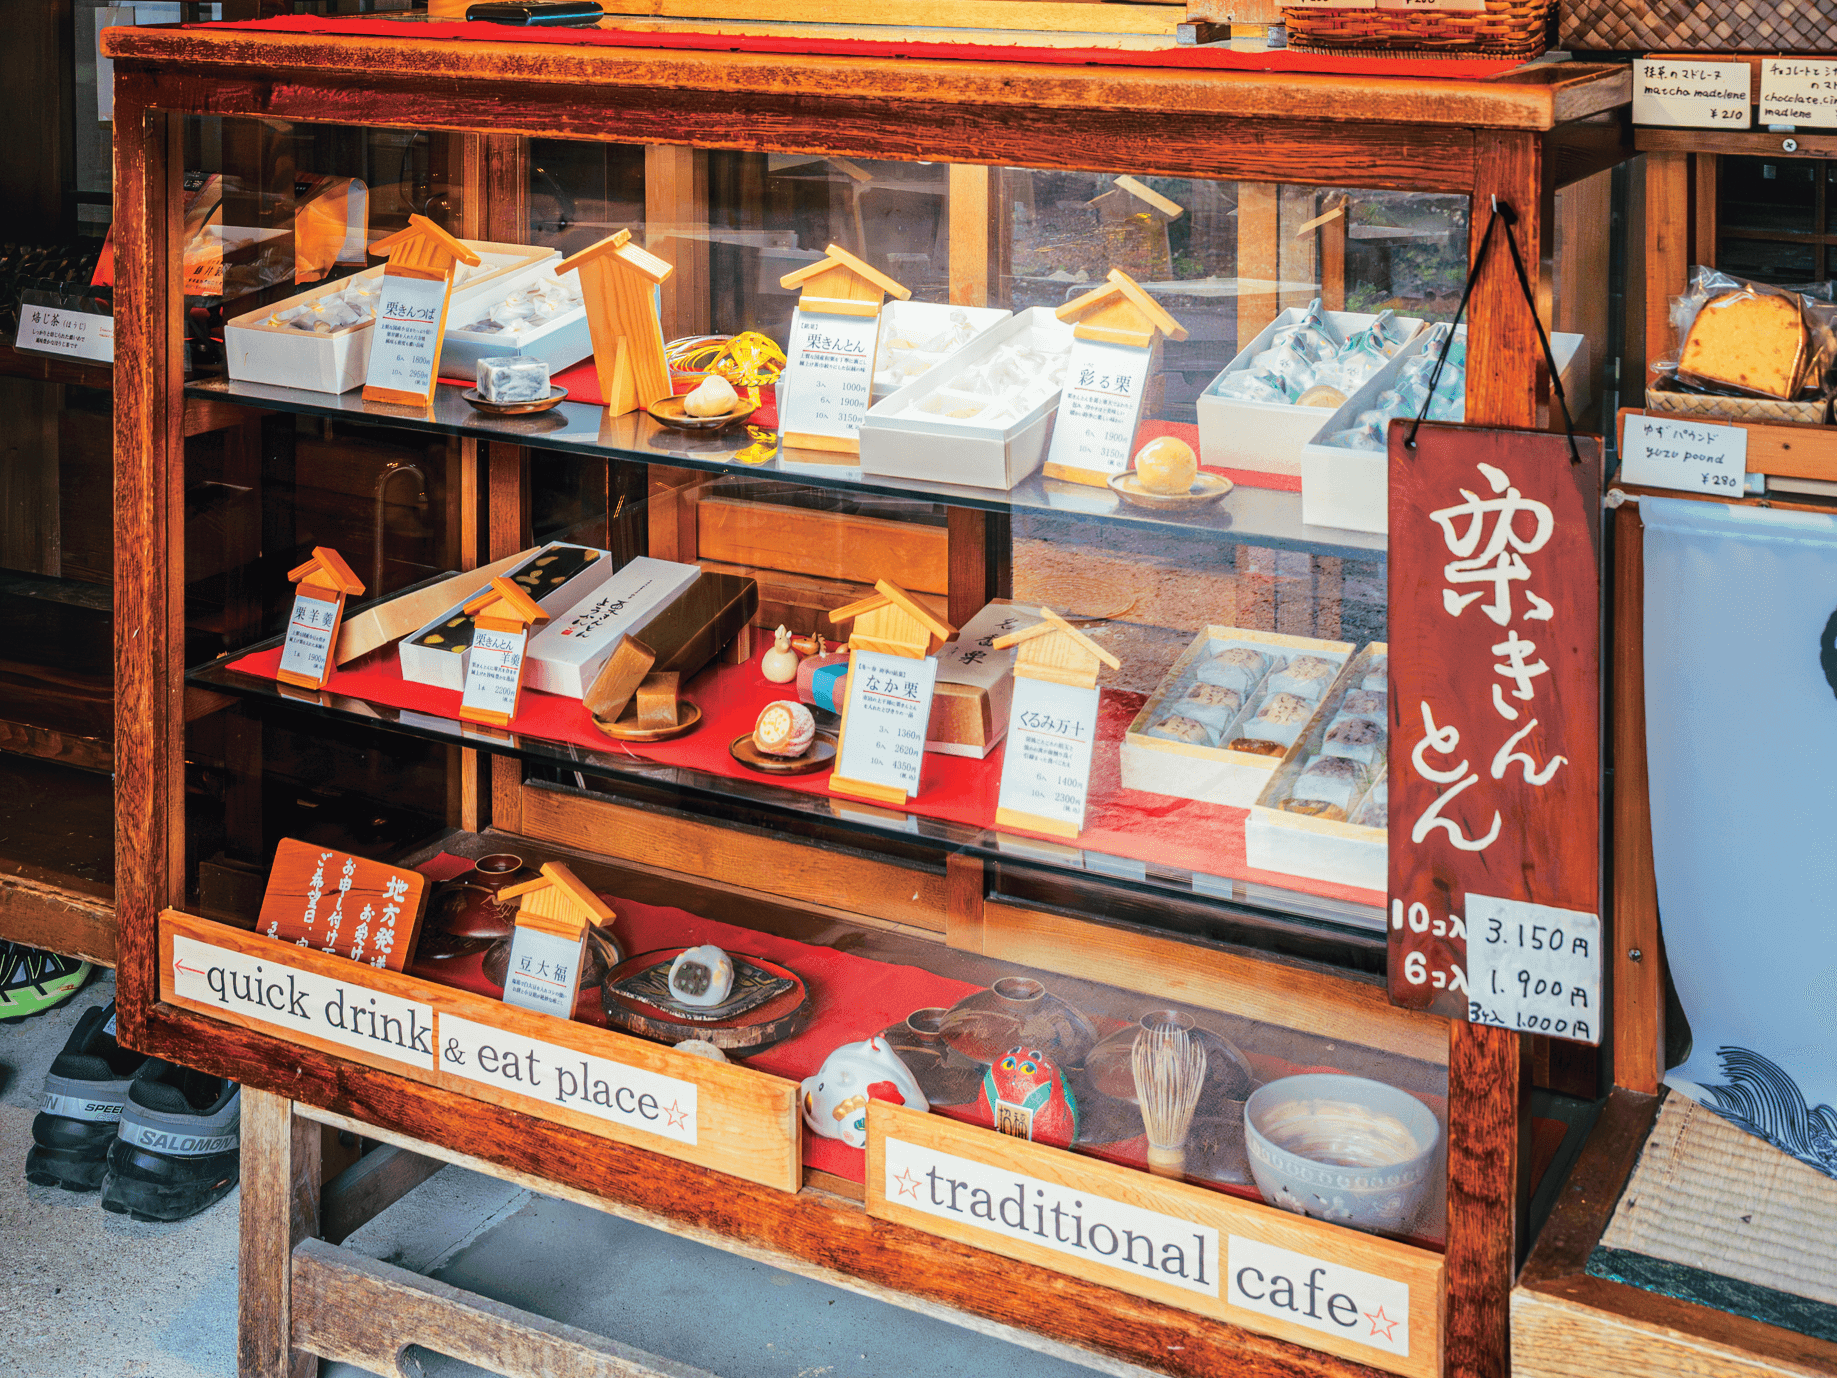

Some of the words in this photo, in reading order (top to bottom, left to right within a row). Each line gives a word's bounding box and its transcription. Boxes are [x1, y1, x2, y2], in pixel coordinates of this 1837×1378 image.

[1644, 85, 1690, 97] matcha
[31, 311, 60, 326] 焙じ茶
[385, 302, 436, 320] 栗きんつば
[807, 333, 866, 353] 栗きんとん
[1078, 369, 1132, 393] 彩る栗
[1673, 429, 1719, 444] パウンド
[294, 606, 333, 627] 栗羊羹
[475, 633, 513, 650] 栗きんとん
[866, 675, 919, 698] なか栗
[1021, 711, 1084, 736] くるみ万十
[519, 955, 568, 982] 豆大福
[206, 960, 311, 1021] quick
[325, 988, 432, 1056] drink
[444, 1036, 468, 1066] &
[478, 1040, 543, 1086] eat
[555, 1059, 660, 1122] place
[139, 1129, 235, 1152] SALOMON
[927, 1165, 1211, 1287] traditional
[1236, 1267, 1360, 1328] cafe
